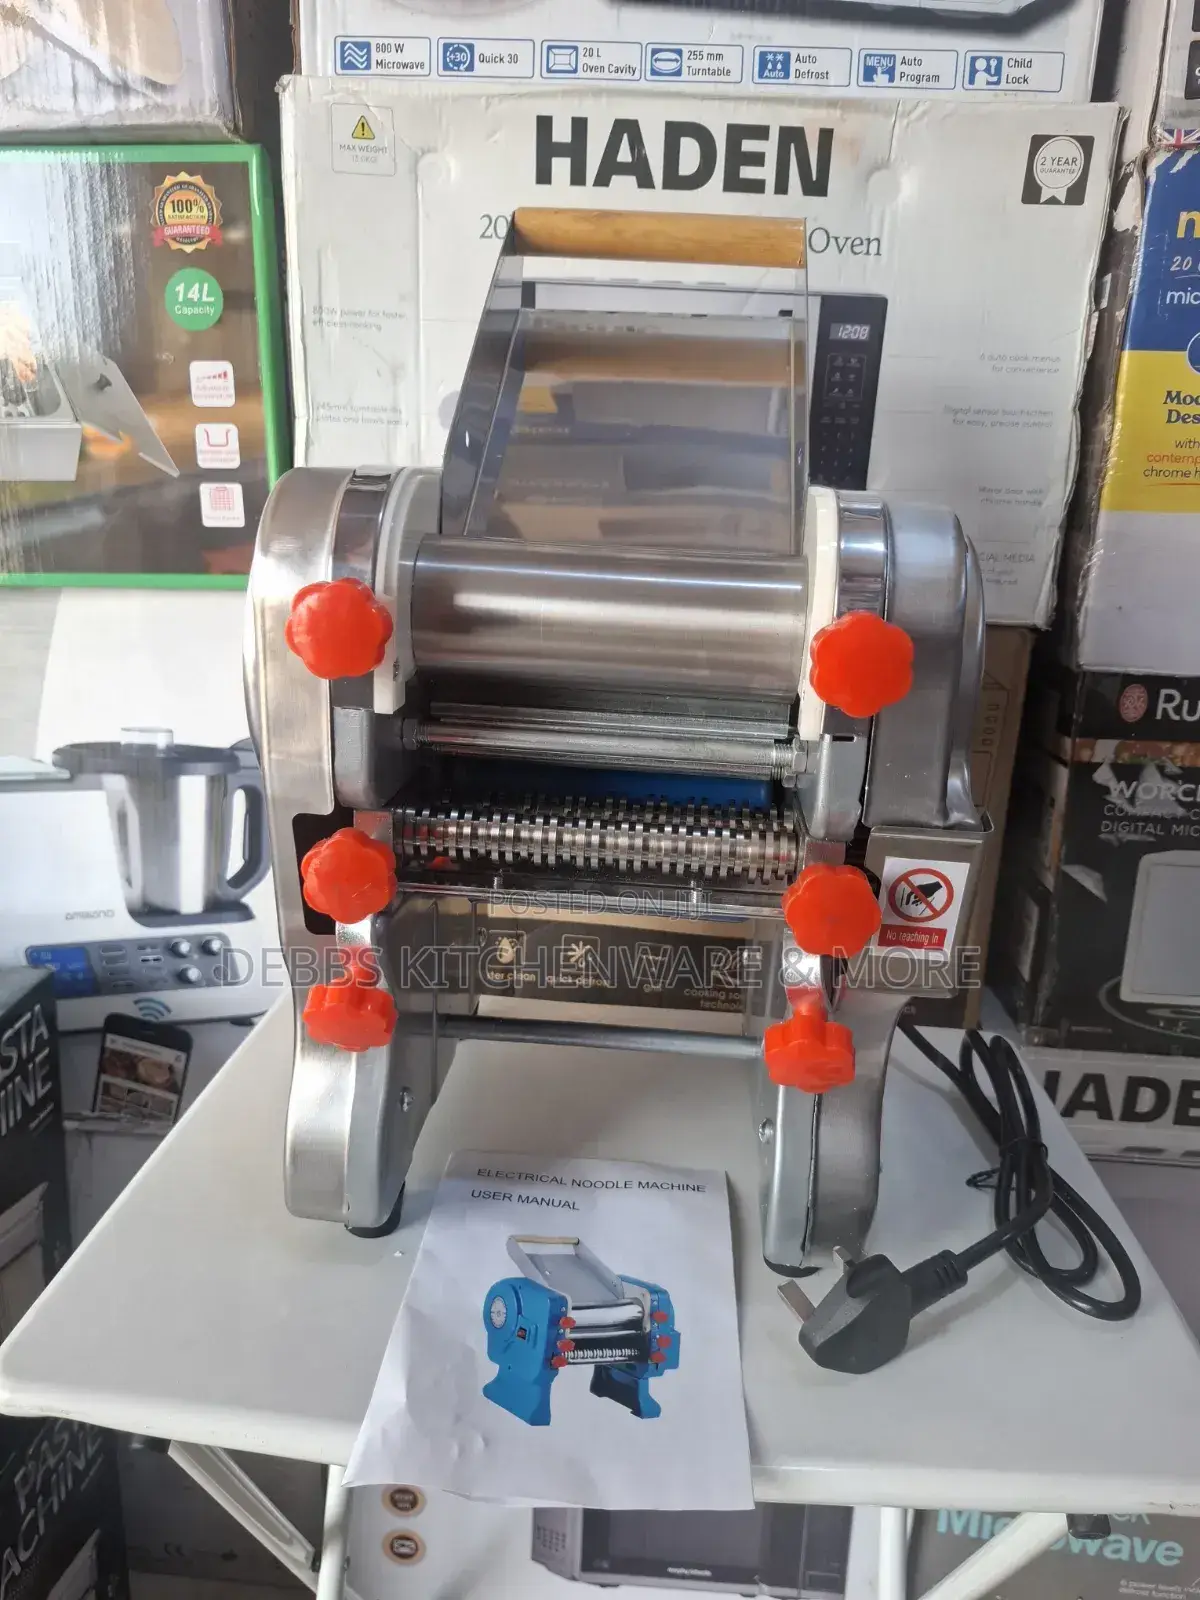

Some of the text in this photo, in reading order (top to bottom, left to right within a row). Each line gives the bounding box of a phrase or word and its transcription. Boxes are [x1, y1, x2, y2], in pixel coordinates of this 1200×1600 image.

[375, 43, 405, 54] 800 W
[582, 47, 602, 58] 20 L
[478, 53, 519, 64] Quick 30
[687, 50, 724, 61] 255 mm
[795, 53, 818, 64] Auto
[865, 56, 894, 67] MENU
[900, 56, 923, 67] Auto
[375, 59, 425, 70] Microwave
[582, 63, 637, 76] Oven Cavity
[1007, 58, 1033, 69] Child
[687, 65, 732, 77] Turntable
[763, 71, 785, 79] Auto
[794, 69, 830, 80] Defrost
[900, 72, 940, 84] Program
[1006, 74, 1029, 85] Lock
[340, 144, 388, 154] MAX WEIGHT
[535, 114, 835, 197] HADEN
[1040, 156, 1078, 166] 2 YEAR
[169, 198, 205, 213] 100%
[164, 224, 210, 236] GUARANTEED
[479, 214, 510, 240] 20
[808, 226, 882, 257] Oven
[1170, 256, 1193, 271] 20
[174, 282, 215, 302] 14L
[174, 304, 215, 317] Capacity
[1175, 437, 1200, 449] with
[1143, 466, 1192, 478] chrome
[1100, 821, 1165, 836] DIGITAL
[886, 930, 897, 941] No
[900, 931, 930, 946] reaching
[684, 987, 726, 1001] cooking
[476, 1168, 707, 1193] ELECTRICAL NOODLE MACHINE
[471, 1189, 580, 1211] USER MANUAL
